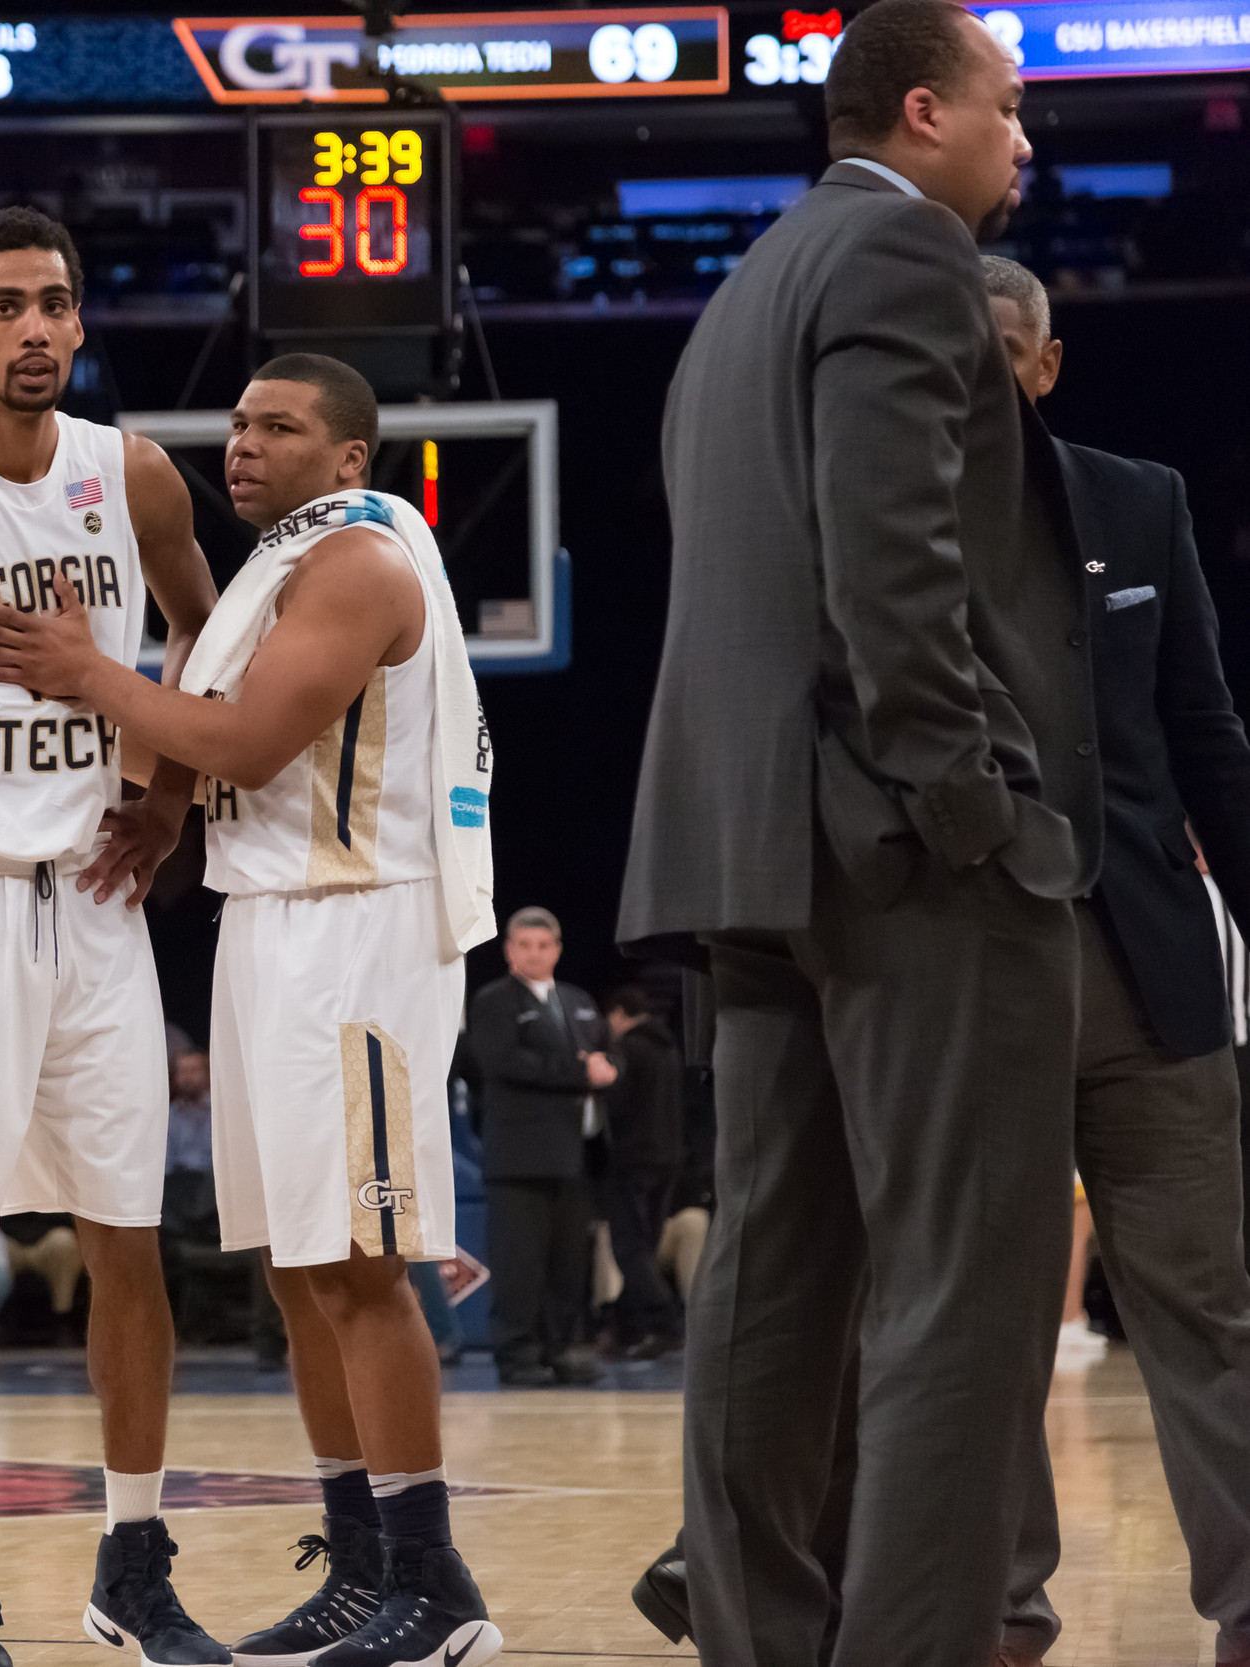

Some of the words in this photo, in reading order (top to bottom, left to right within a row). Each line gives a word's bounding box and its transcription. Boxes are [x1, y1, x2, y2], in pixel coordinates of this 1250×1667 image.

[483, 41, 551, 73] TECH
[589, 24, 677, 83] 69
[745, 33, 845, 85] 3:3
[1055, 21, 1103, 53] CSU
[314, 130, 422, 186] 3:39
[299, 186, 407, 277] 30
[357, 1180, 413, 1215] GT
